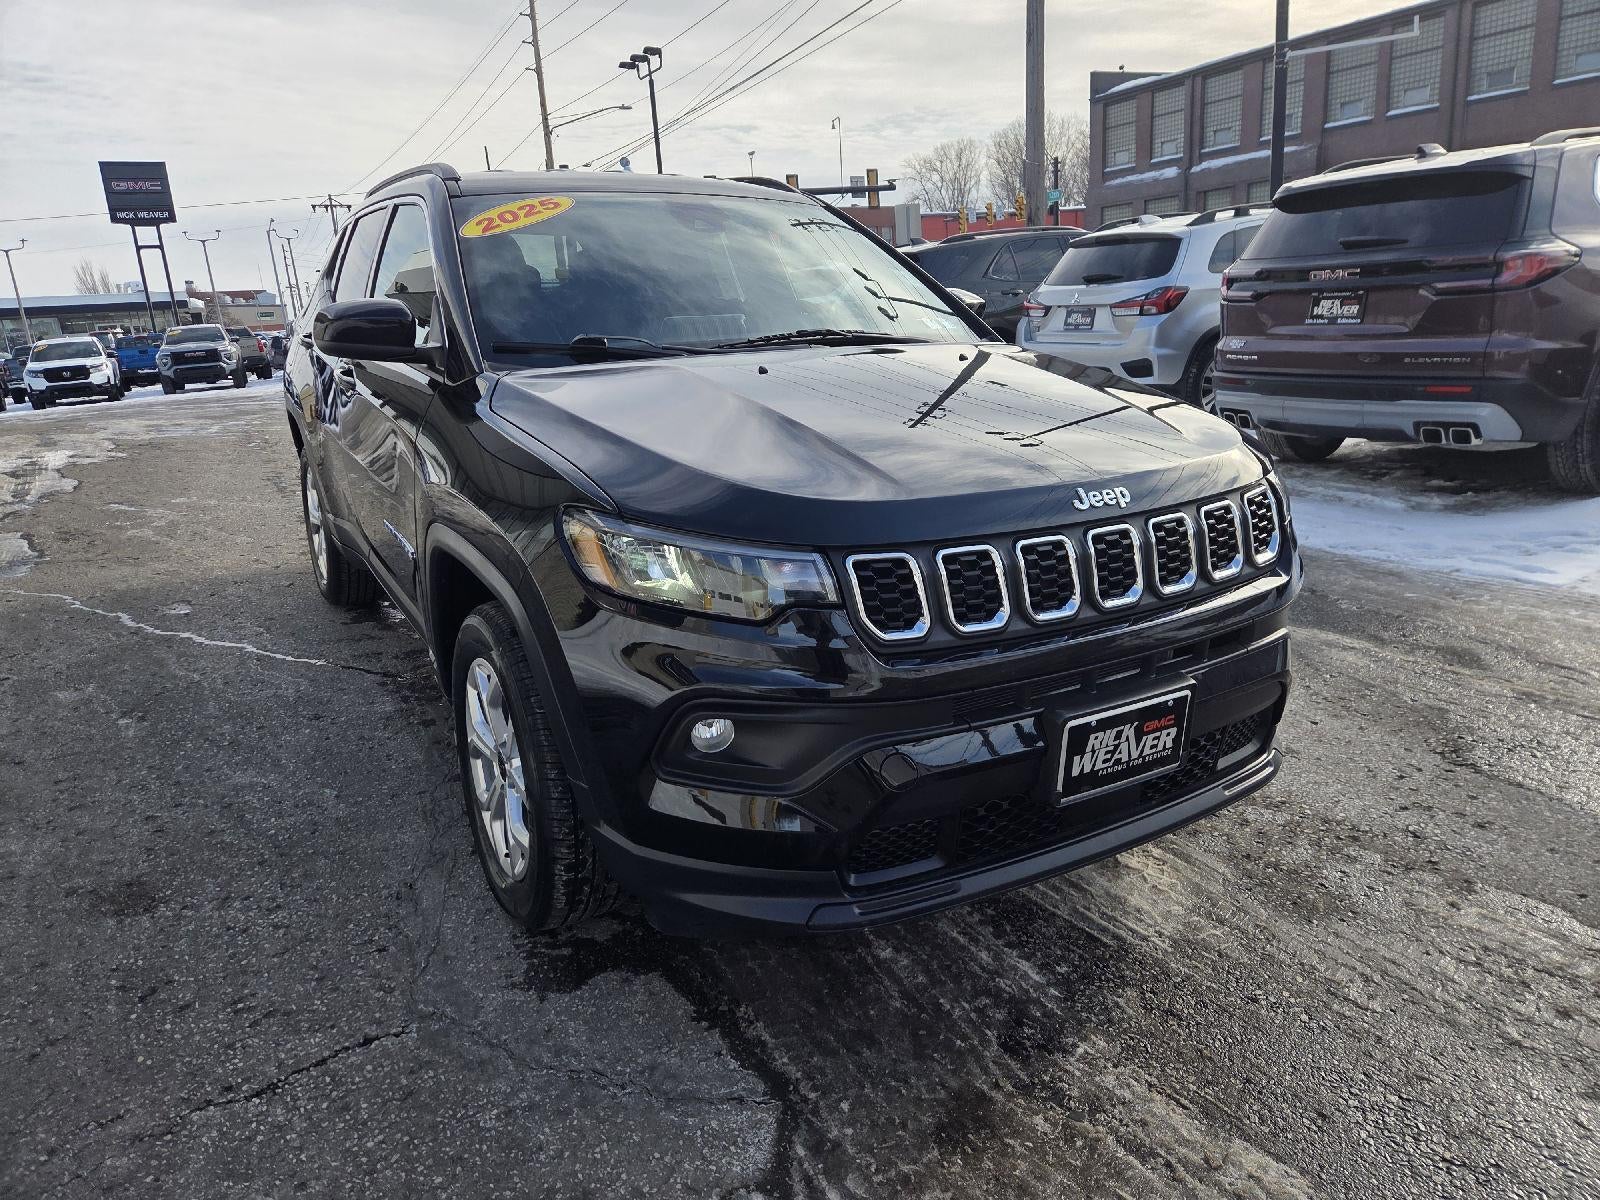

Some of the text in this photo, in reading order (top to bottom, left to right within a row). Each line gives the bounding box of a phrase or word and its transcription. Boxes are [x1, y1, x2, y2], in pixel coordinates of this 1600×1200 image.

[111, 181, 162, 190] GMC
[116, 211, 136, 219] RICK
[475, 198, 562, 234] 2025
[1309, 268, 1361, 281] GMC
[1313, 304, 1360, 316] WEAVER
[1072, 486, 1131, 510] Jeep
[1143, 714, 1175, 732] GMC
[1085, 721, 1139, 753] RICK
[1071, 727, 1178, 777] WEAVER
[1098, 748, 1173, 777] FAMOUS FOR SERVICE
